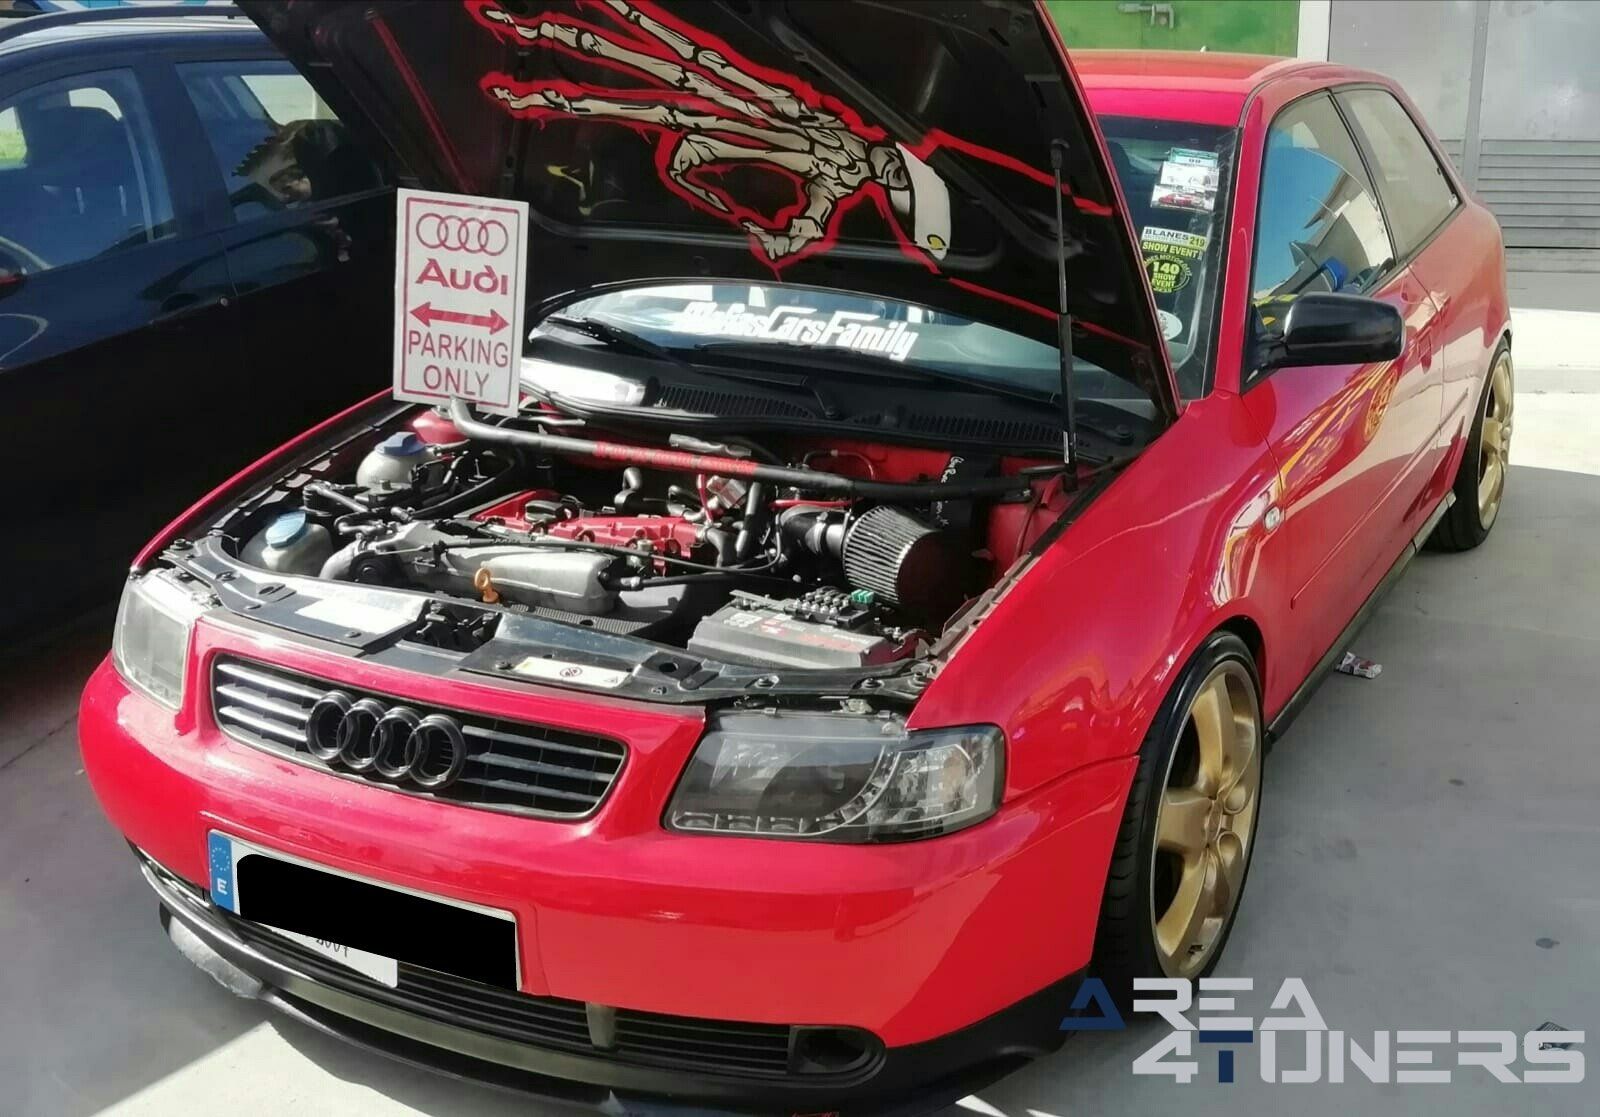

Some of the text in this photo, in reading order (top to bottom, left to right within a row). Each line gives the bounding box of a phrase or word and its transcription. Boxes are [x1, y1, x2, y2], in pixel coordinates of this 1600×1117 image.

[1144, 229, 1187, 240] BLANES
[1142, 241, 1168, 252] SHOW
[1153, 261, 1180, 275] 140
[415, 257, 509, 295] Audi
[1151, 278, 1176, 288] EVENT
[1153, 273, 1176, 281] SHOW
[408, 329, 509, 369] PARKING
[423, 364, 490, 398] ONLY
[217, 878, 228, 895] E
